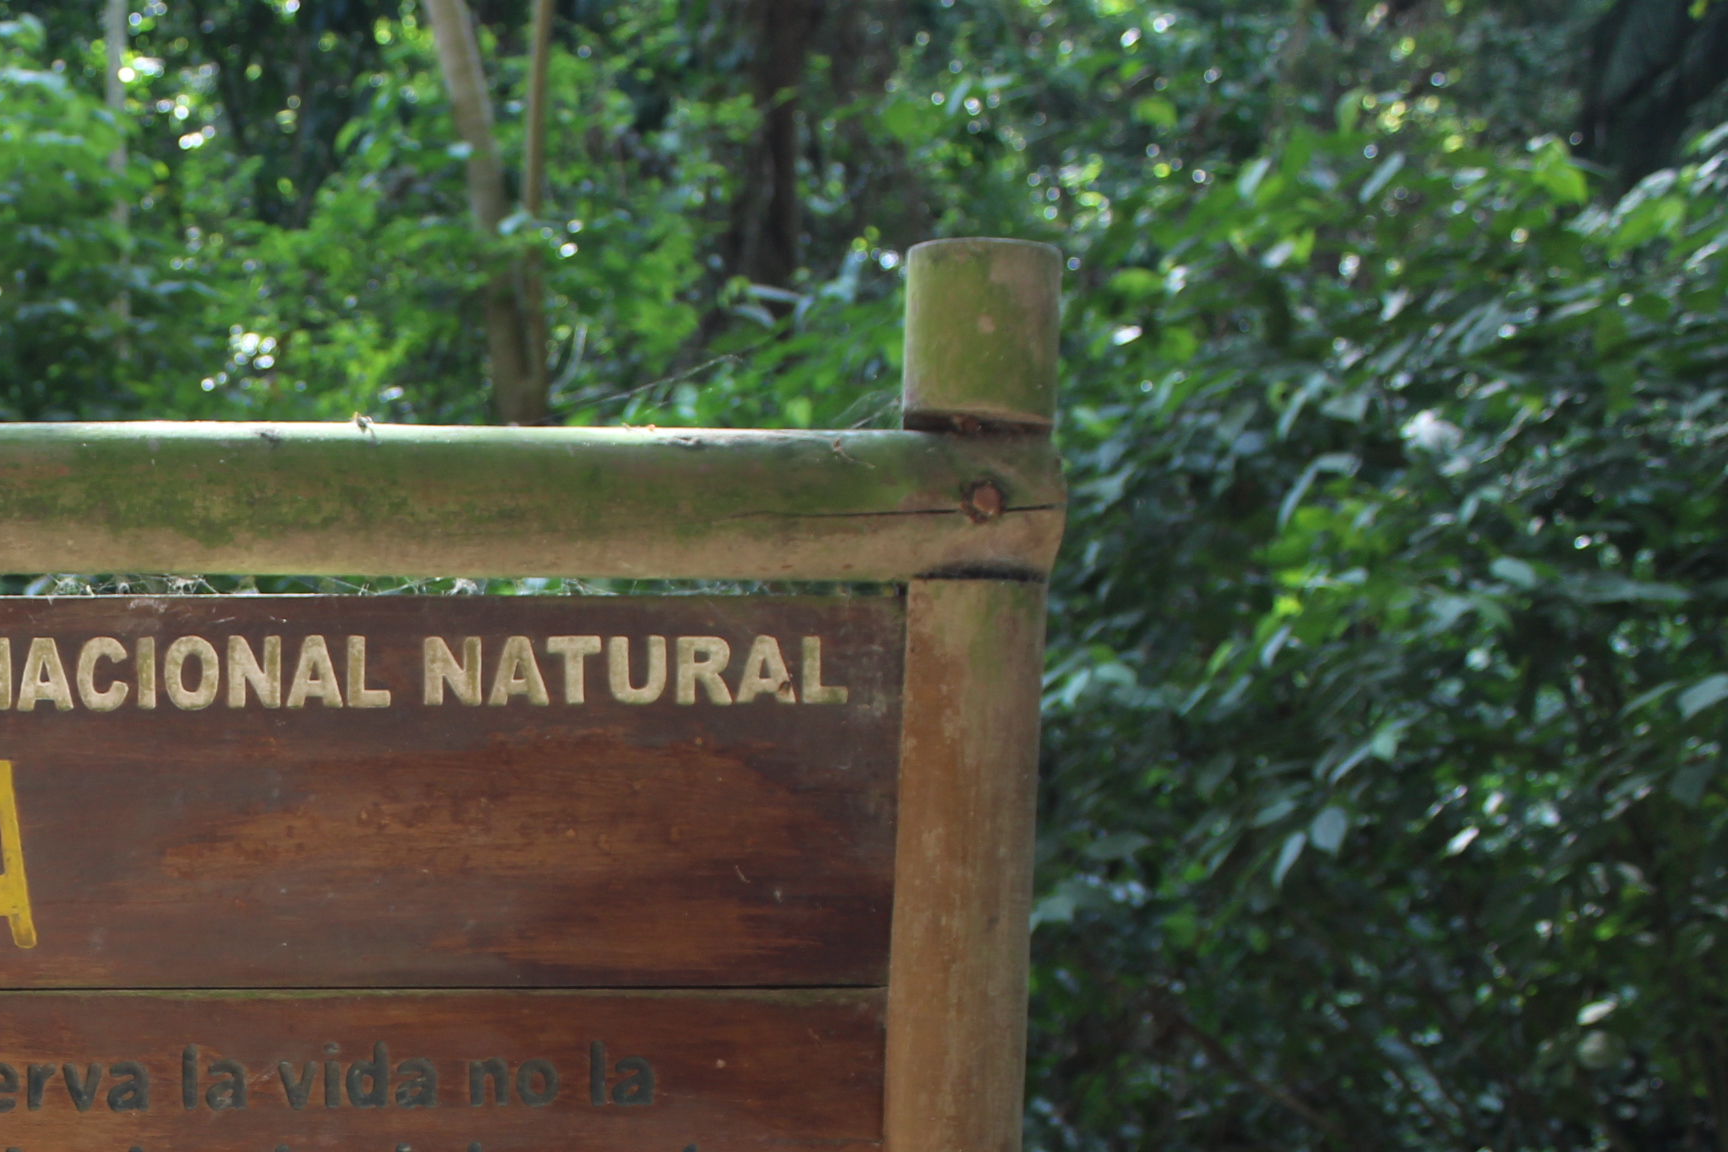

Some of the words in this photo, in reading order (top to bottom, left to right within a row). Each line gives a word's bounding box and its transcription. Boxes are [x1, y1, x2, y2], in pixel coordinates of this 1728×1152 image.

[423, 634, 848, 706] NATURAL
[182, 1043, 248, 1111] la
[278, 1041, 438, 1110] vida
[469, 1056, 559, 1108] no
[590, 1040, 656, 1108] la
